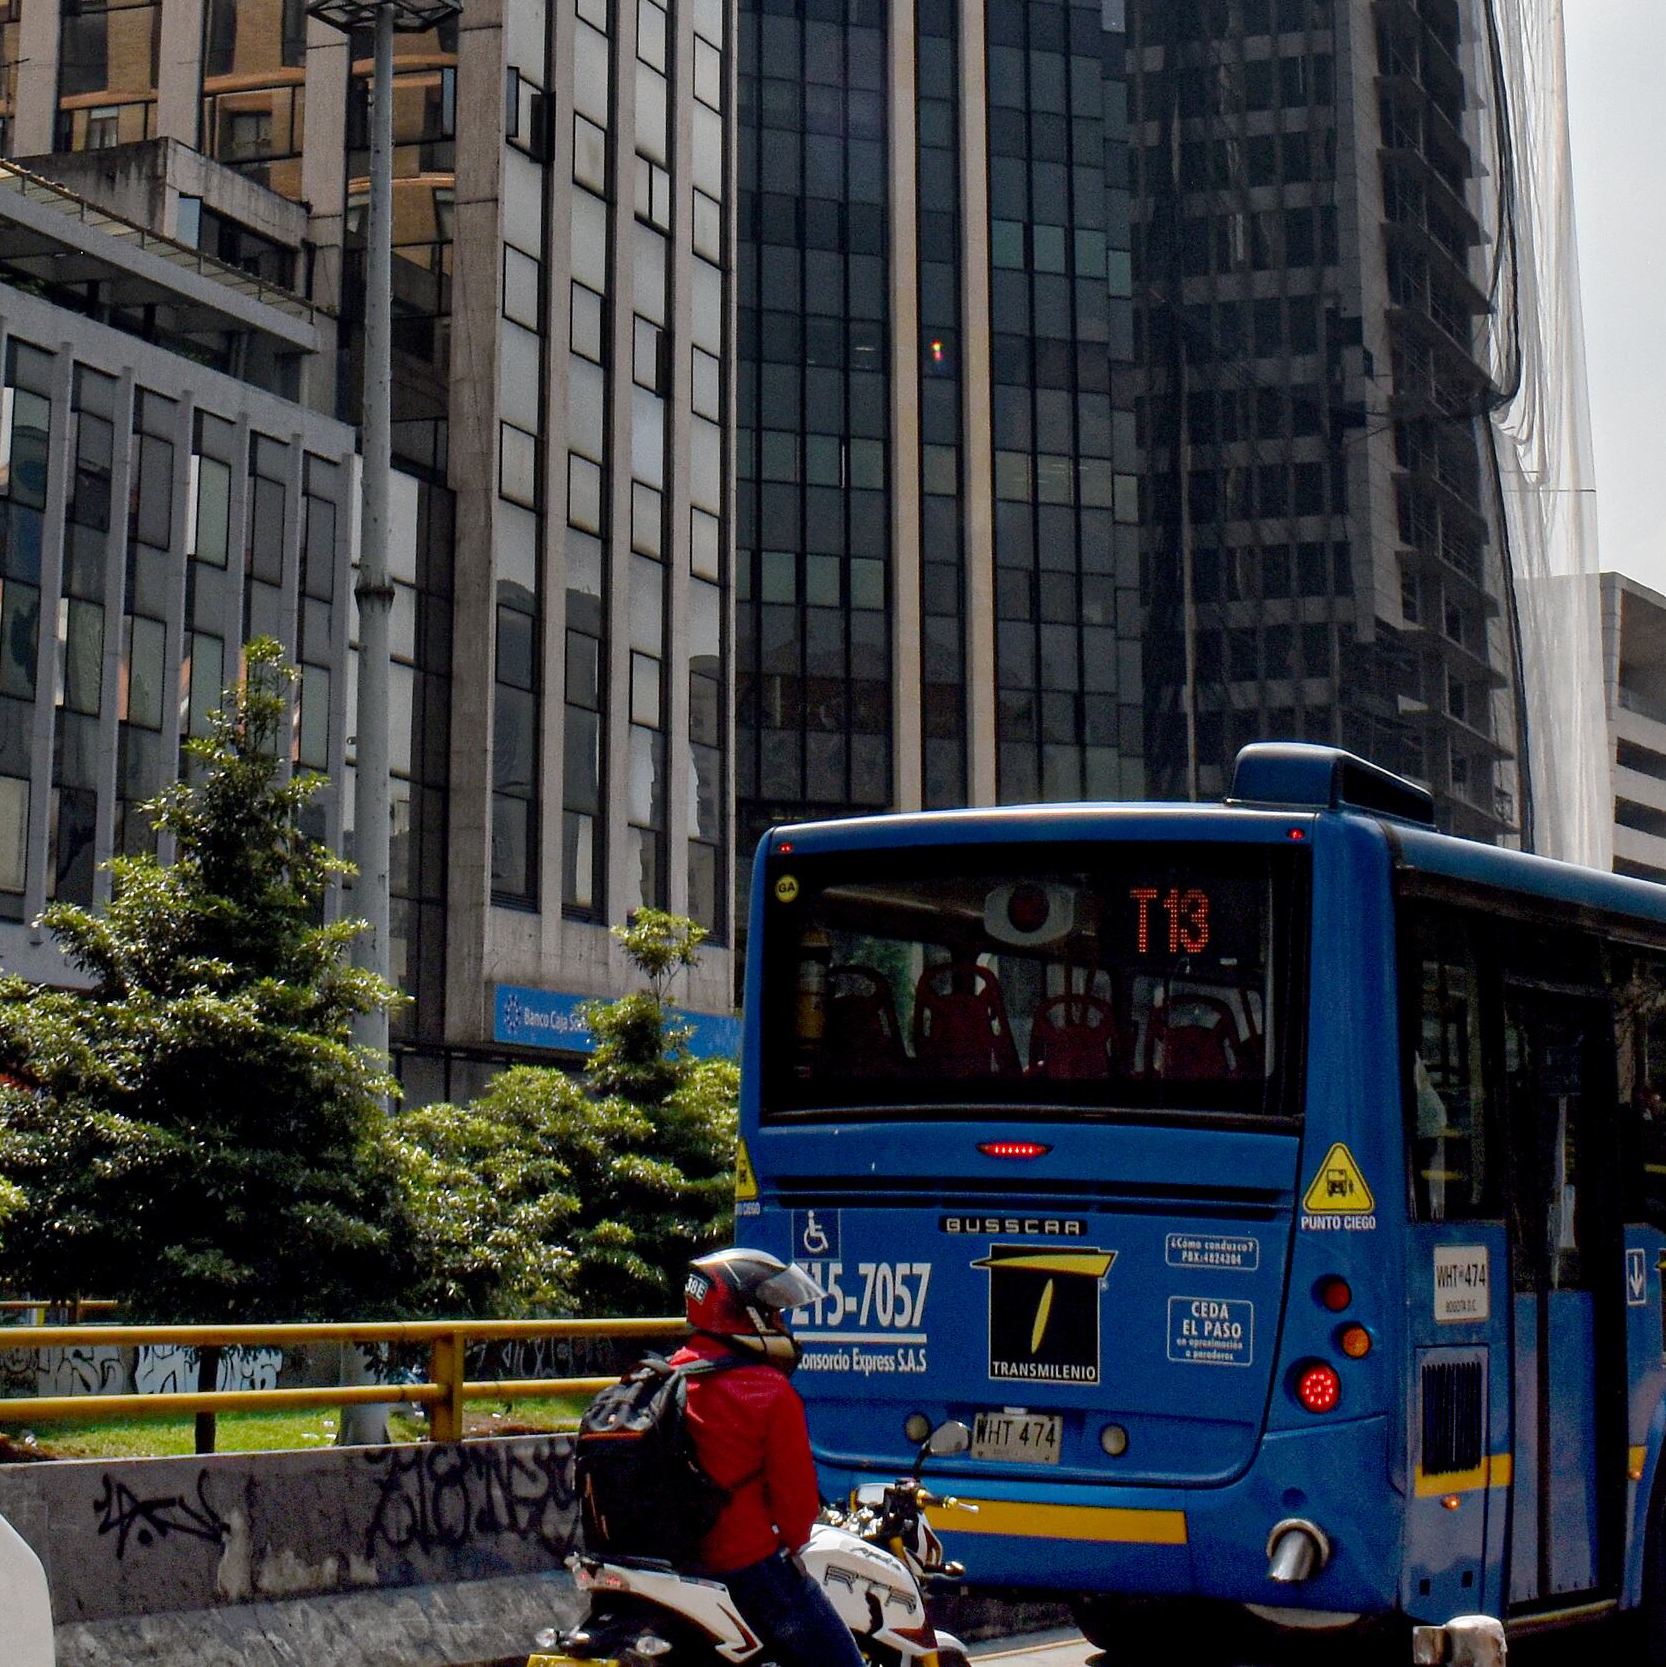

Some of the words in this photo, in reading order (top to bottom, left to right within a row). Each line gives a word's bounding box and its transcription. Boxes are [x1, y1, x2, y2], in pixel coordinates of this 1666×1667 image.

[778, 881, 796, 894] GA
[524, 1007, 550, 1029] Banco
[946, 1218, 1080, 1235] BUSSCAR
[1301, 1216, 1341, 1230] PUNTO
[1344, 1216, 1377, 1230] CIEGO
[1436, 1265, 1458, 1289] WHT
[1465, 1264, 1486, 1288] 474
[1191, 1301, 1229, 1319] CEDA
[1182, 1319, 1198, 1336] EL
[1204, 1321, 1242, 1339] PASO
[852, 1348, 896, 1376] Express
[897, 1348, 927, 1372] S.A.S
[992, 1361, 1097, 1380] TRANSMILENIO
[976, 1417, 1014, 1446] WHT
[1019, 1421, 1056, 1448] 474
